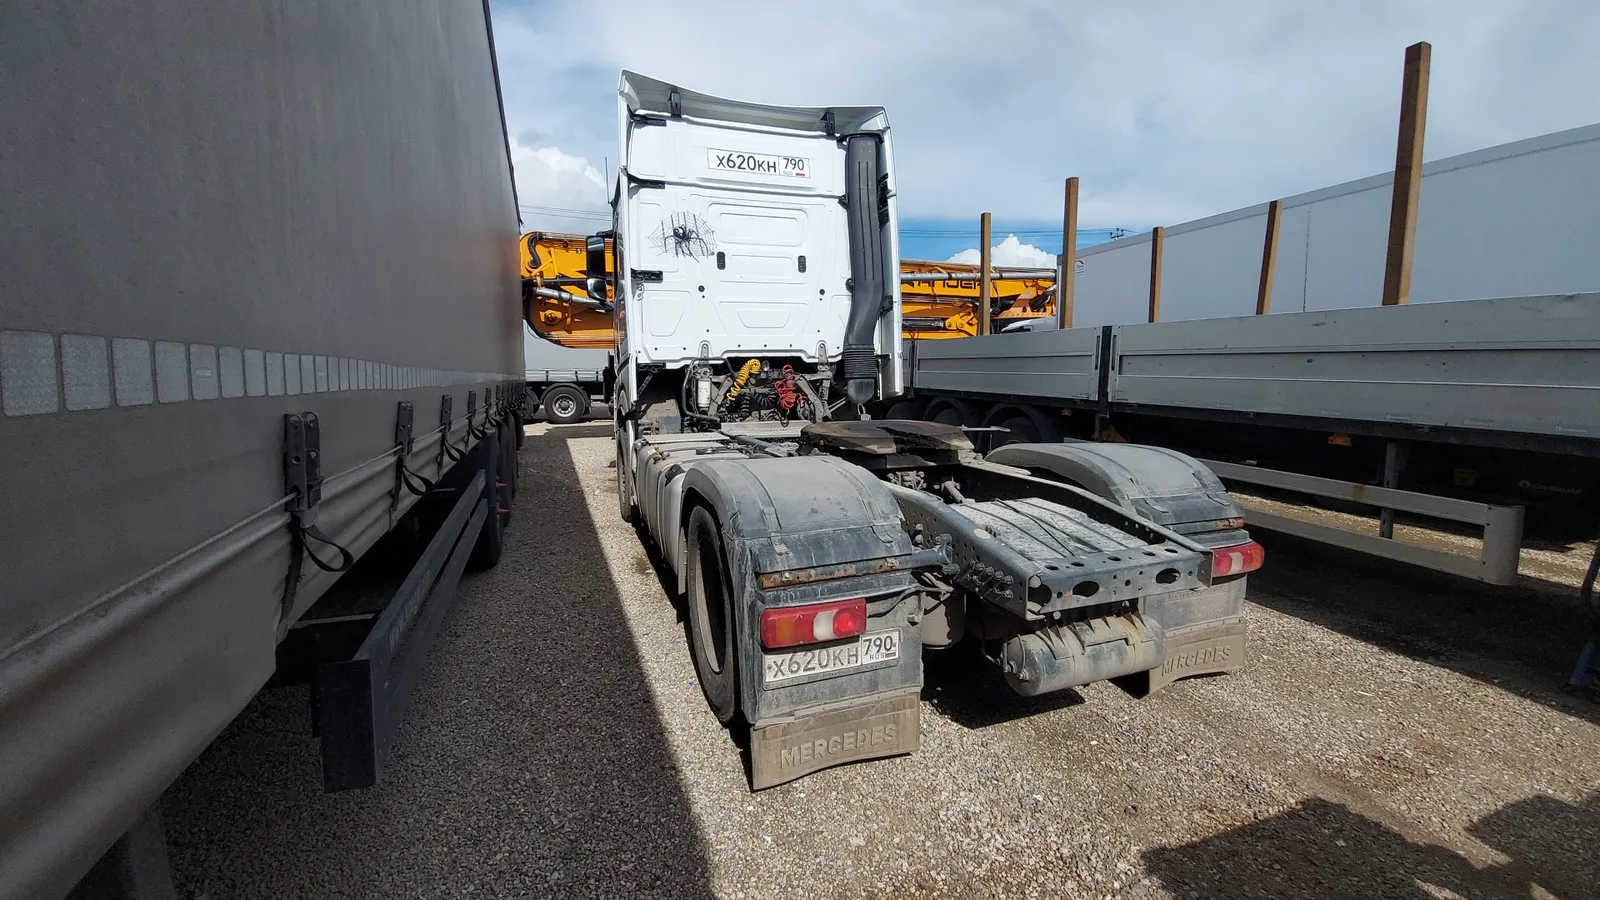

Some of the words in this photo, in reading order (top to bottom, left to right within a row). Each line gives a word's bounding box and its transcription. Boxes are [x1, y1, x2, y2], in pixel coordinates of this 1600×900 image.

[783, 157, 805, 171] 790
[863, 635, 893, 656] 790
[869, 652, 885, 661] RUS
[780, 723, 896, 768] MERCEDES
